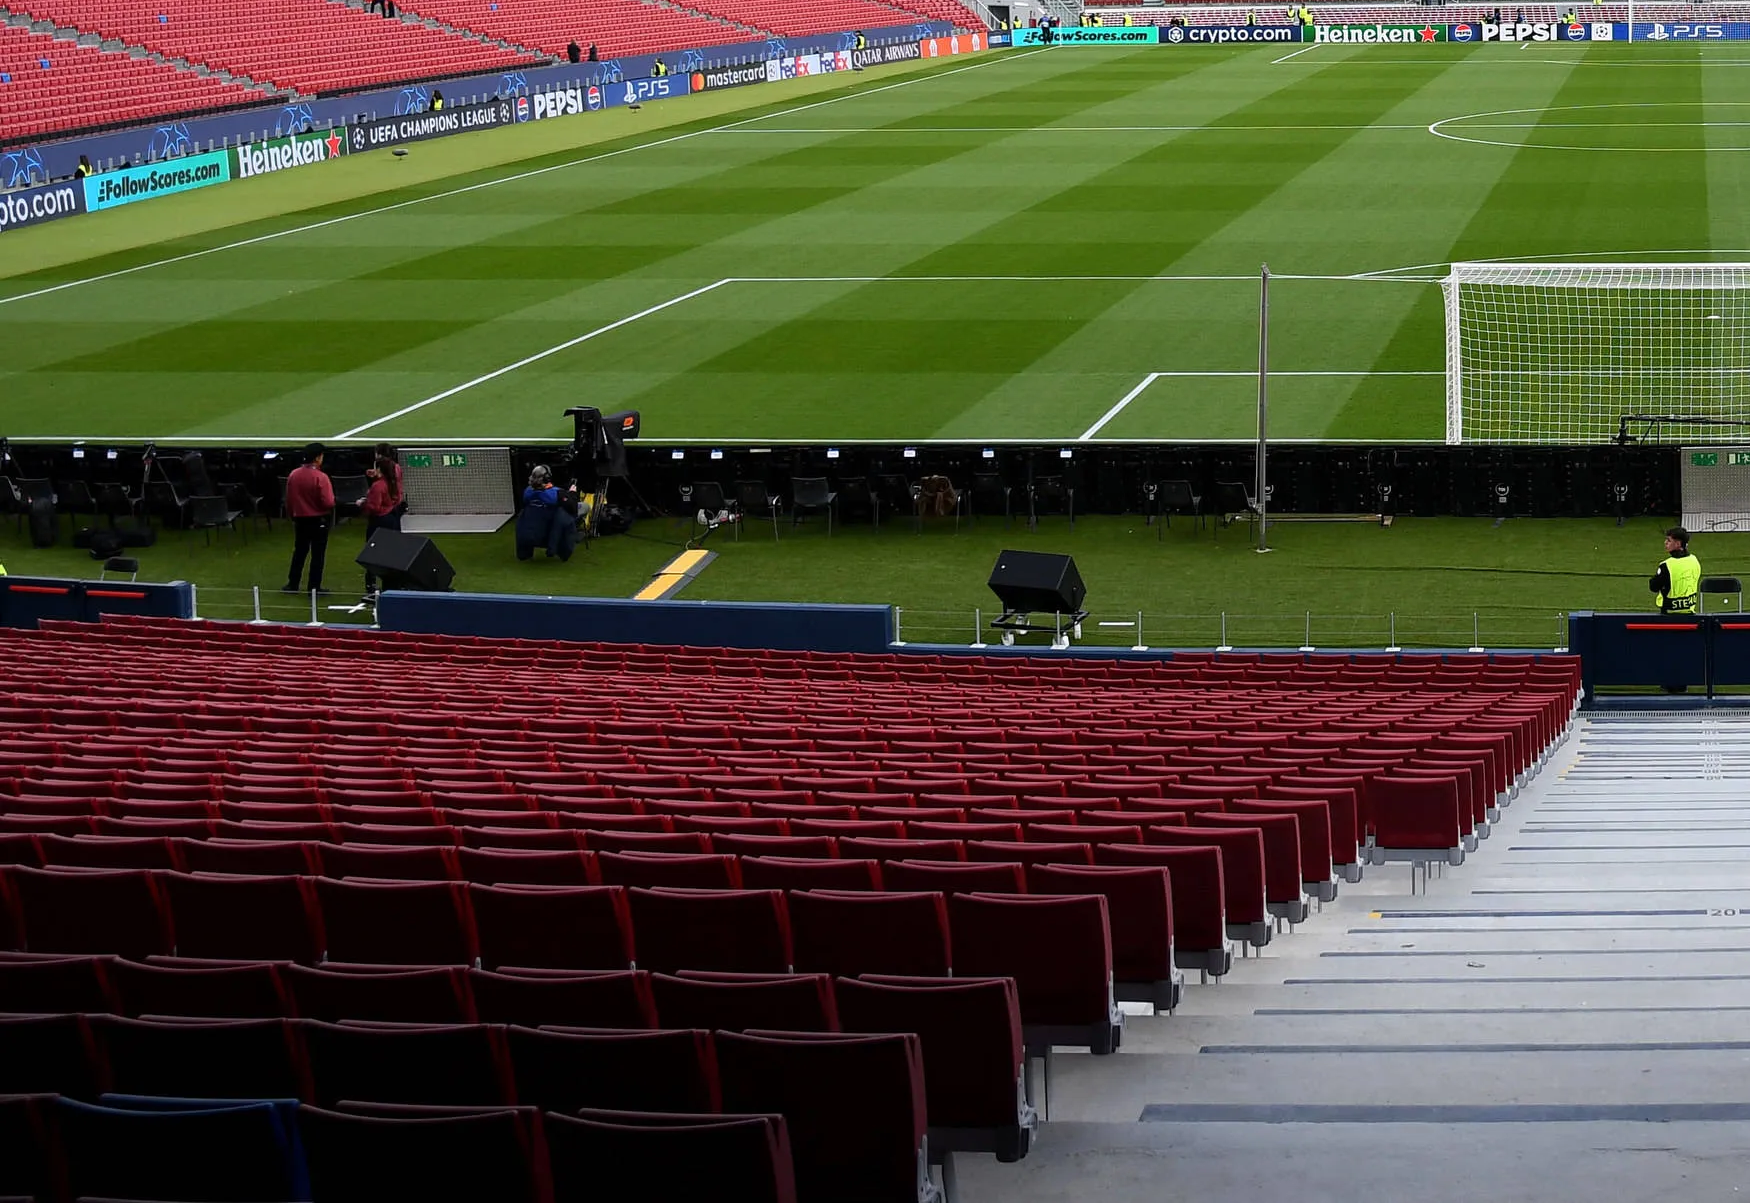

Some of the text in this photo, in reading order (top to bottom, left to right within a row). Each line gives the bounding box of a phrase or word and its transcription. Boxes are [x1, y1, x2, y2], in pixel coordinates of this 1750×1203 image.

[1189, 26, 1292, 43] crypto.com
[1314, 25, 1416, 42] Heineken
[1481, 23, 1558, 41] PEPSI
[1673, 25, 1724, 37] PS5
[820, 51, 848, 73] FedEx
[853, 43, 919, 67] QATAR AIRWAYS
[706, 63, 765, 87] mastercard
[780, 56, 809, 79] FedEx
[638, 79, 669, 97] PS5
[534, 88, 584, 120] PEPSI
[369, 107, 497, 144] UEFA CHAMPIONS LEAGUE
[237, 136, 326, 179] Heineken
[104, 161, 221, 201] FollowScores.com
[1711, 908, 1736, 917] 20
